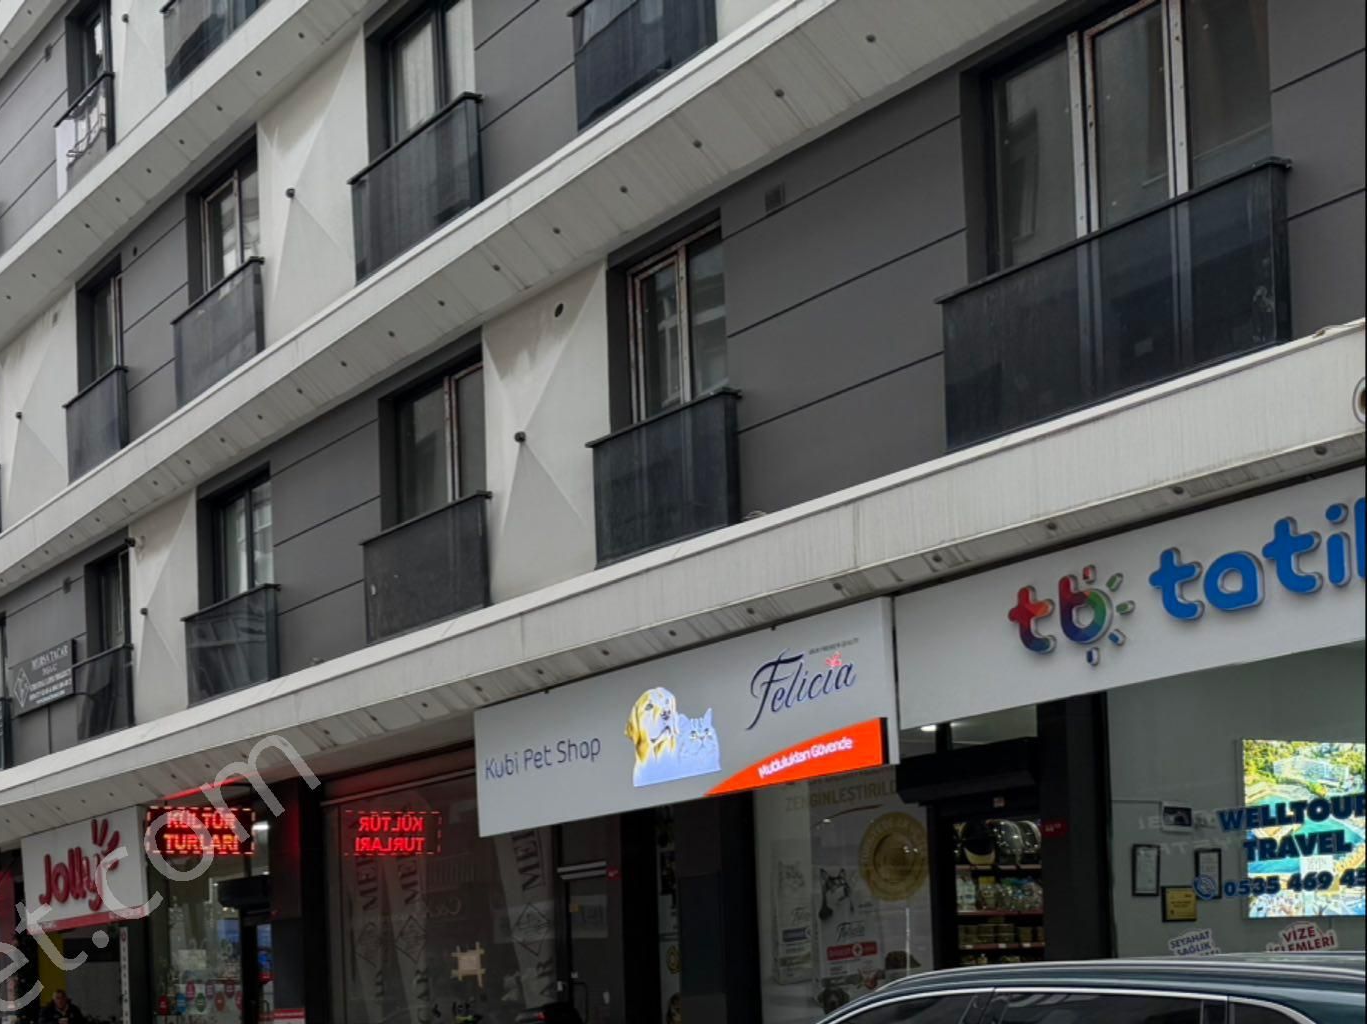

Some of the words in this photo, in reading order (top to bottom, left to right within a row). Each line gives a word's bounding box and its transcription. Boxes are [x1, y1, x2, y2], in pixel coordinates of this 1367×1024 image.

[745, 648, 856, 731] Felicia
[485, 752, 519, 779] Kubi
[523, 746, 552, 771] Pet
[556, 738, 601, 763] Shop
[167, 811, 235, 829] KÜLTÜR
[164, 833, 239, 851] TURLARI
[1242, 830, 1353, 861] TRAVEL
[39, 846, 106, 911] Jolly
[1224, 876, 1282, 896] 0535
[1286, 870, 1334, 891] 469
